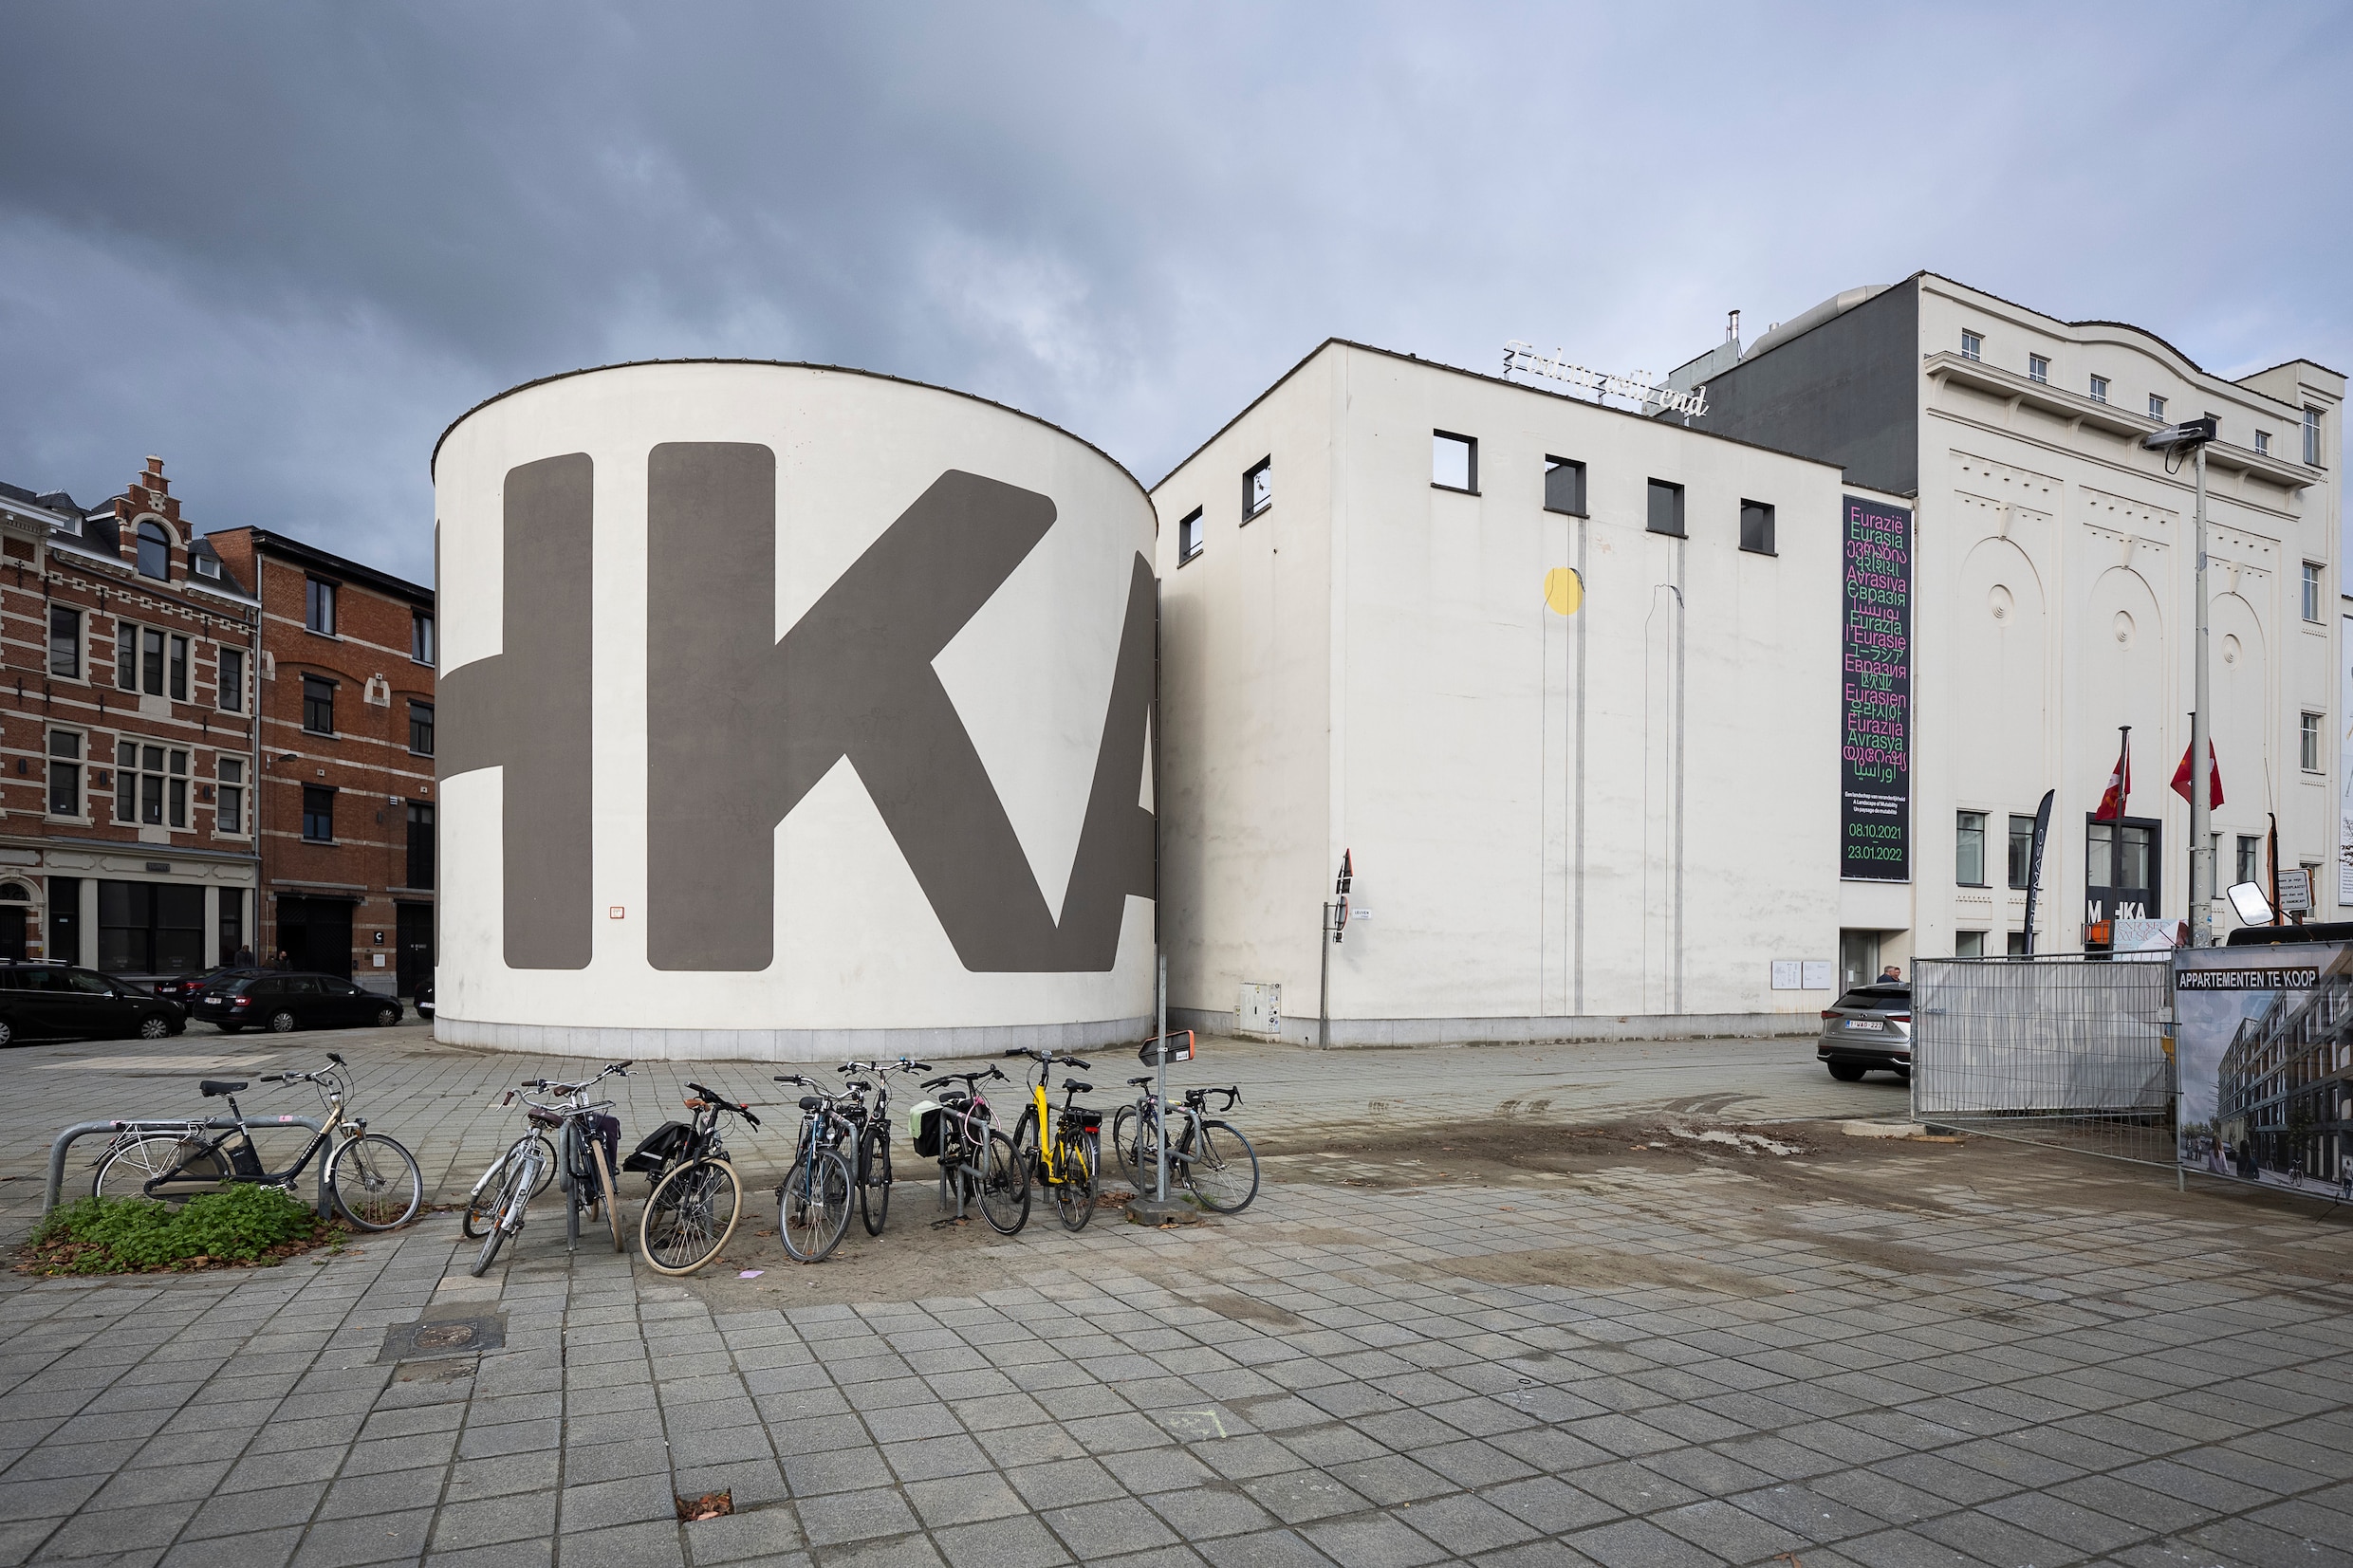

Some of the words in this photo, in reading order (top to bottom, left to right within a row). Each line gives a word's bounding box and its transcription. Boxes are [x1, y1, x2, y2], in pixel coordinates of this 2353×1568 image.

[1659, 385, 1709, 417] end
[1851, 507, 1903, 535] Eurazië
[1851, 521, 1903, 550] Eurasia
[1846, 564, 1906, 594] Avrasiya
[1847, 580, 1906, 607] Євразія
[1850, 610, 1902, 636] Eurazja
[1845, 653, 1906, 679] Евразия
[1850, 643, 1903, 664] ユーラシア
[1861, 671, 1893, 692] 欧亚
[1845, 683, 1906, 708] Eurasien
[1850, 700, 1901, 723] 유라시아
[1847, 712, 1903, 739] Eurazija
[1847, 729, 1903, 754] Avrasya
[1848, 823, 1901, 839] 08.10.2021
[1847, 845, 1902, 861] 23.01.2022
[2087, 900, 2102, 924] M
[2179, 970, 2265, 987] APPARTEMENTEN
[2267, 970, 2282, 987] TE
[2283, 969, 2316, 987] KOOP
